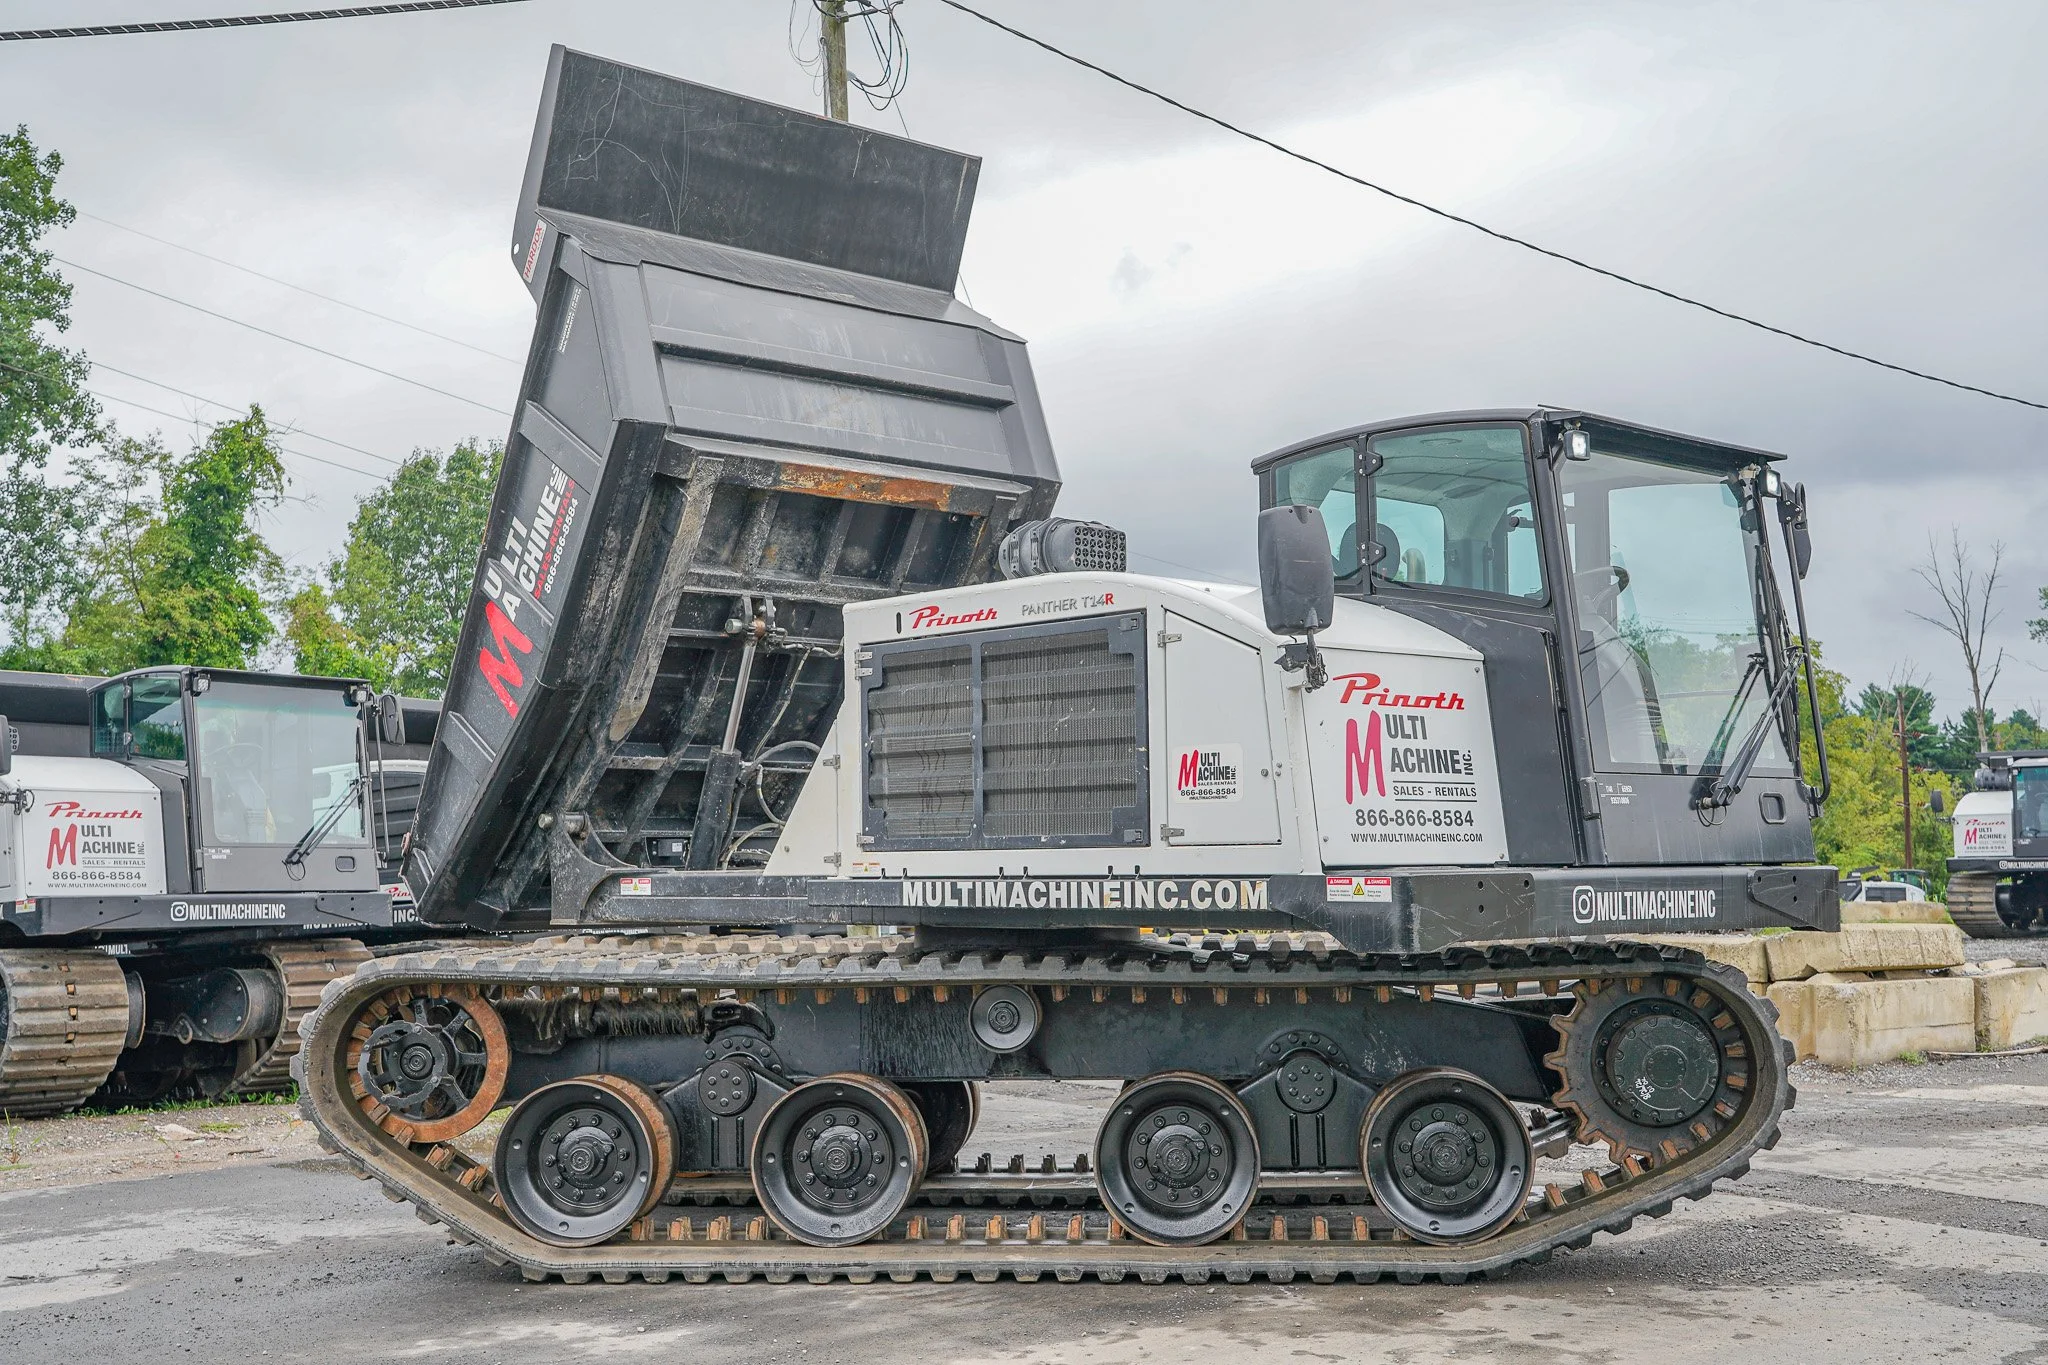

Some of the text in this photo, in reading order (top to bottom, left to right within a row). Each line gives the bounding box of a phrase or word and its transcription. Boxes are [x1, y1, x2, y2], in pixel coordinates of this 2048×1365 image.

[525, 224, 542, 278] HARDOX
[544, 498, 578, 594] 866-866-8584
[1021, 593, 1114, 616] PANTHER T14R
[909, 605, 998, 629] Prinoth
[1333, 672, 1465, 710] Prinoth
[1462, 750, 1474, 775] INC.
[1180, 788, 1237, 796] 866-866-8584
[1393, 786, 1424, 796] SALES
[1435, 786, 1477, 797] RENTALS
[44, 801, 143, 819] Prinoth
[1355, 809, 1474, 827] 866-866-8584
[1351, 833, 1483, 843] WWW.MULTIMACHINEINC.COM
[52, 871, 142, 880] 866-866-8584
[902, 880, 1268, 910] MULTIMACHINEINC.COM
[1597, 889, 1716, 921] MULTIMACHINEINC
[189, 903, 286, 920] MULTIMACHINEINC
